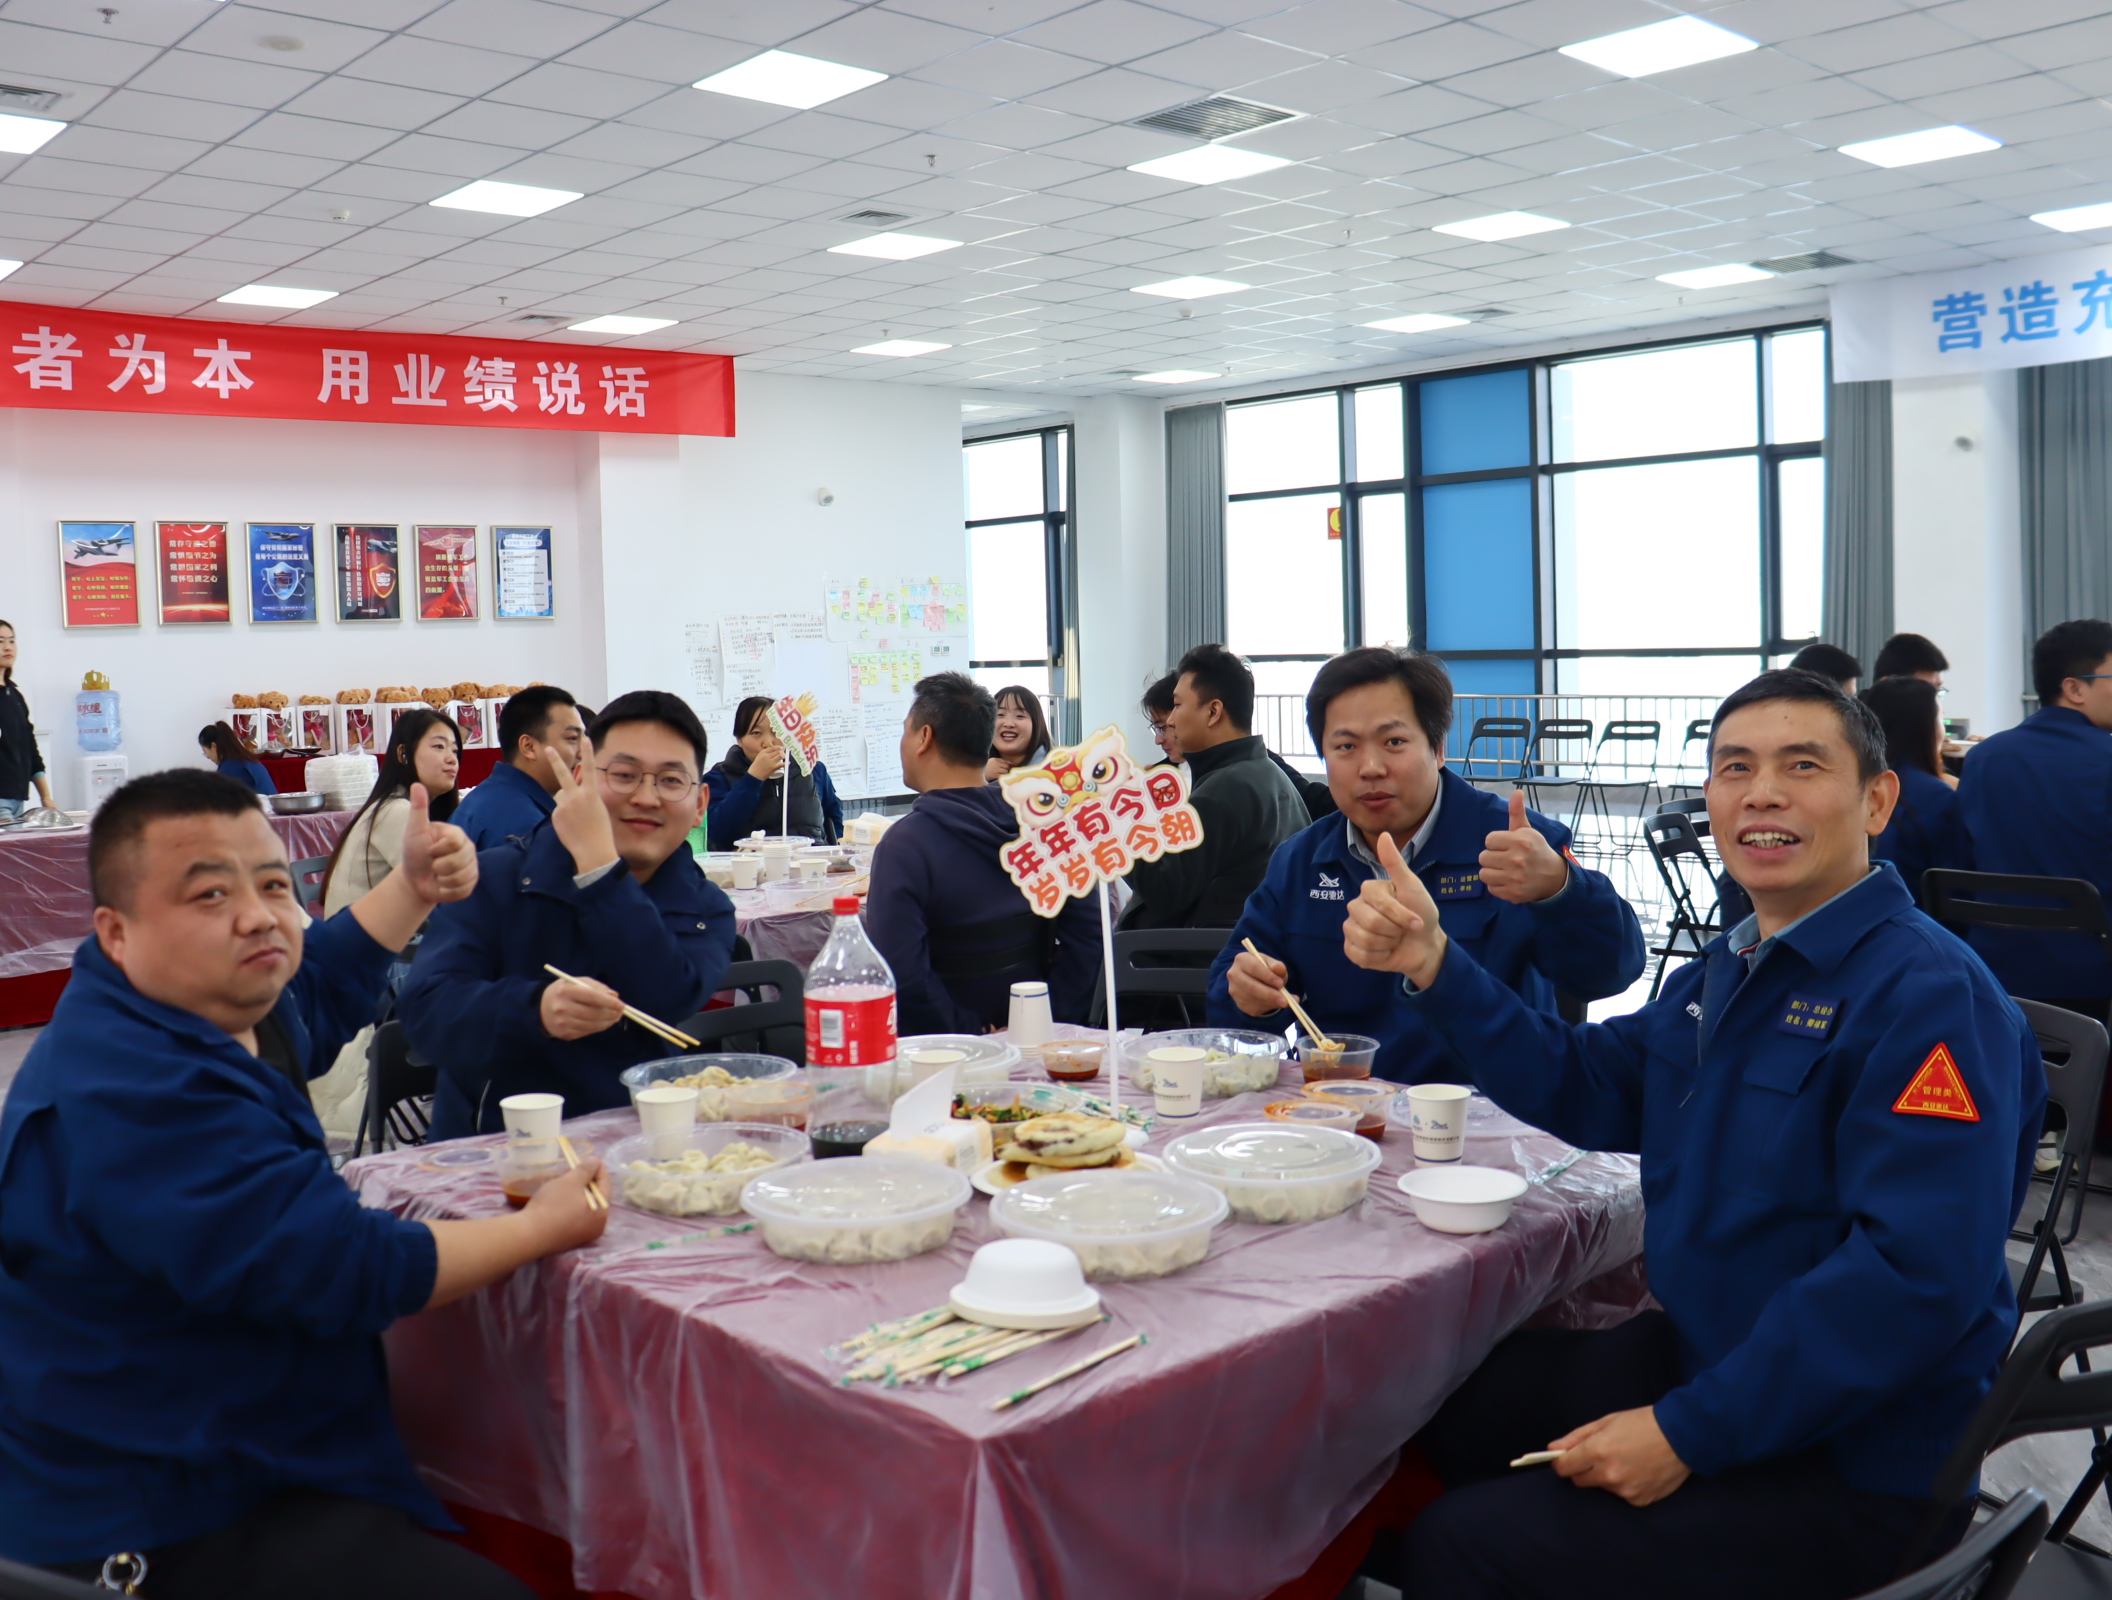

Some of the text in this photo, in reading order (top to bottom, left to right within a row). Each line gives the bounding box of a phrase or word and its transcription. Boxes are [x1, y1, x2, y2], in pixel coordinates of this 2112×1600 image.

[1932, 269, 2112, 353] 营造充
[11, 325, 650, 418] 者为本 用业绩说话
[767, 708, 809, 775] Happy Birthday
[774, 694, 819, 769] 生日快乐
[1007, 772, 1182, 880] 年年有今日
[1028, 810, 1197, 911] 岁岁有今朝
[1309, 889, 1345, 900] 西安驰达
[1685, 1001, 1703, 1021] 西
[1922, 1085, 1952, 1098] 管理类
